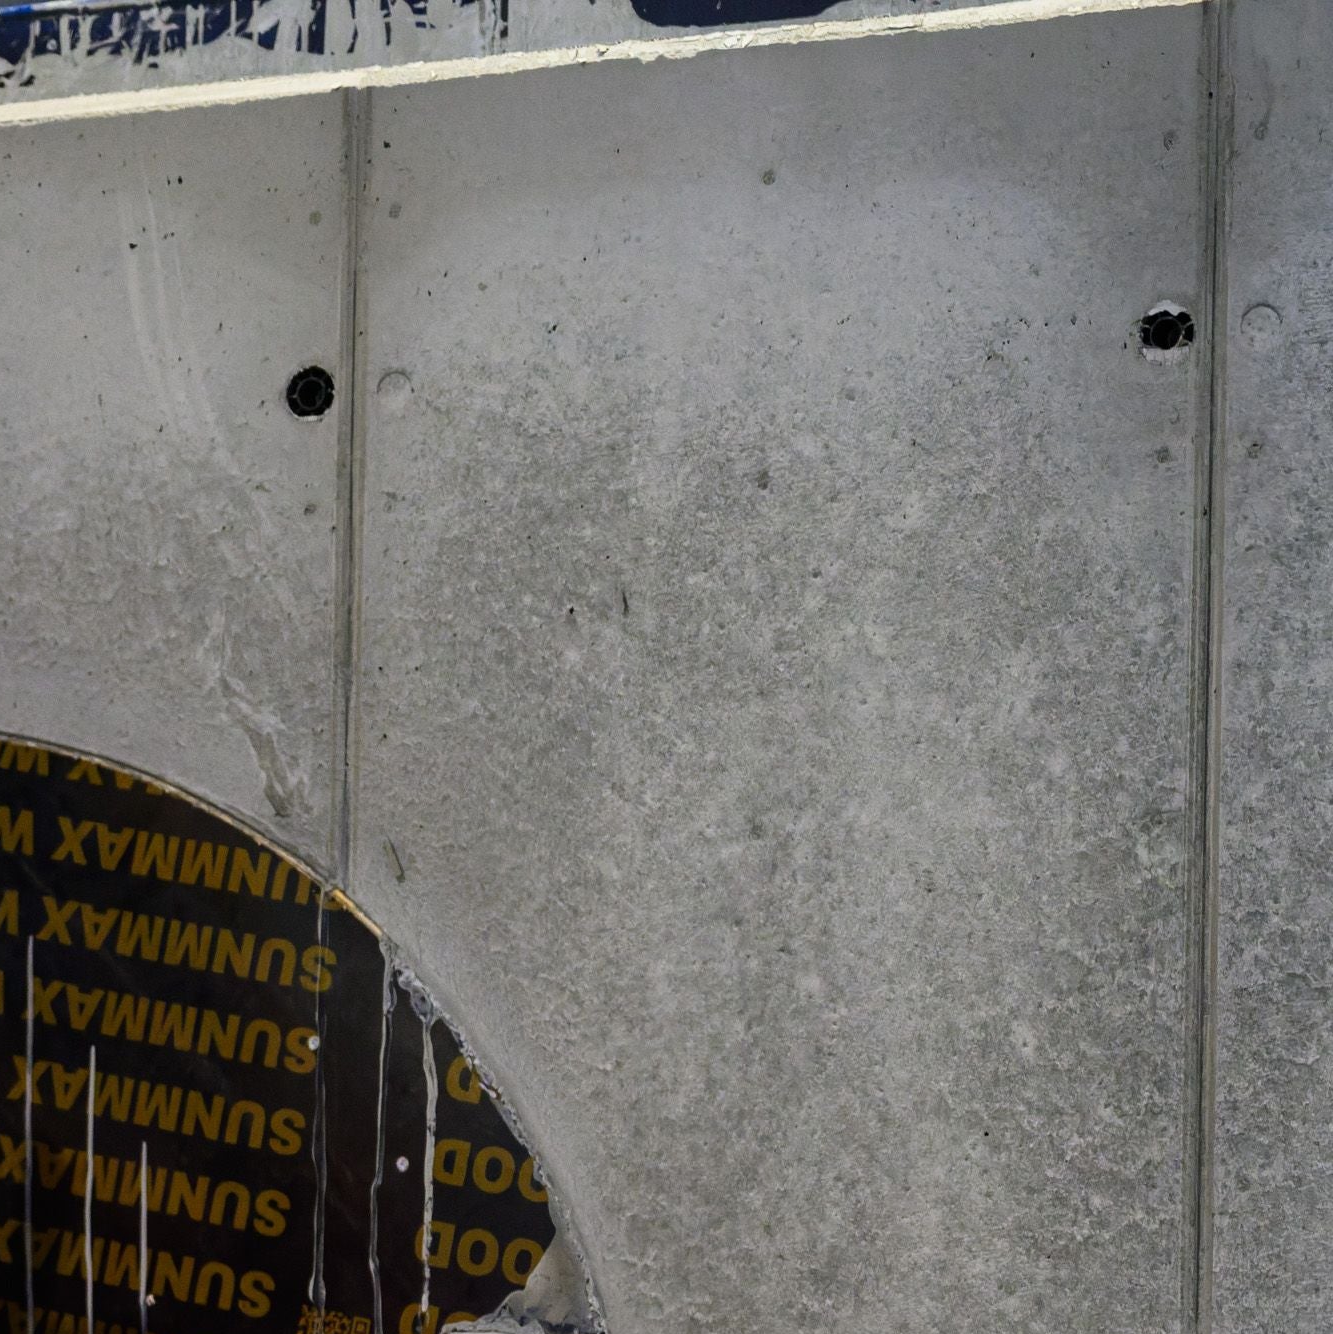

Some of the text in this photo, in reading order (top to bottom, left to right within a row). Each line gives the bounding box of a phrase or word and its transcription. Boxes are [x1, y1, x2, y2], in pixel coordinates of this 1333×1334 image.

[49, 815, 338, 908] UNMMAX
[36, 895, 338, 993] SUNMMAX
[22, 976, 320, 1075] SUNMMAX
[6, 1054, 306, 1157] SUNMMAX
